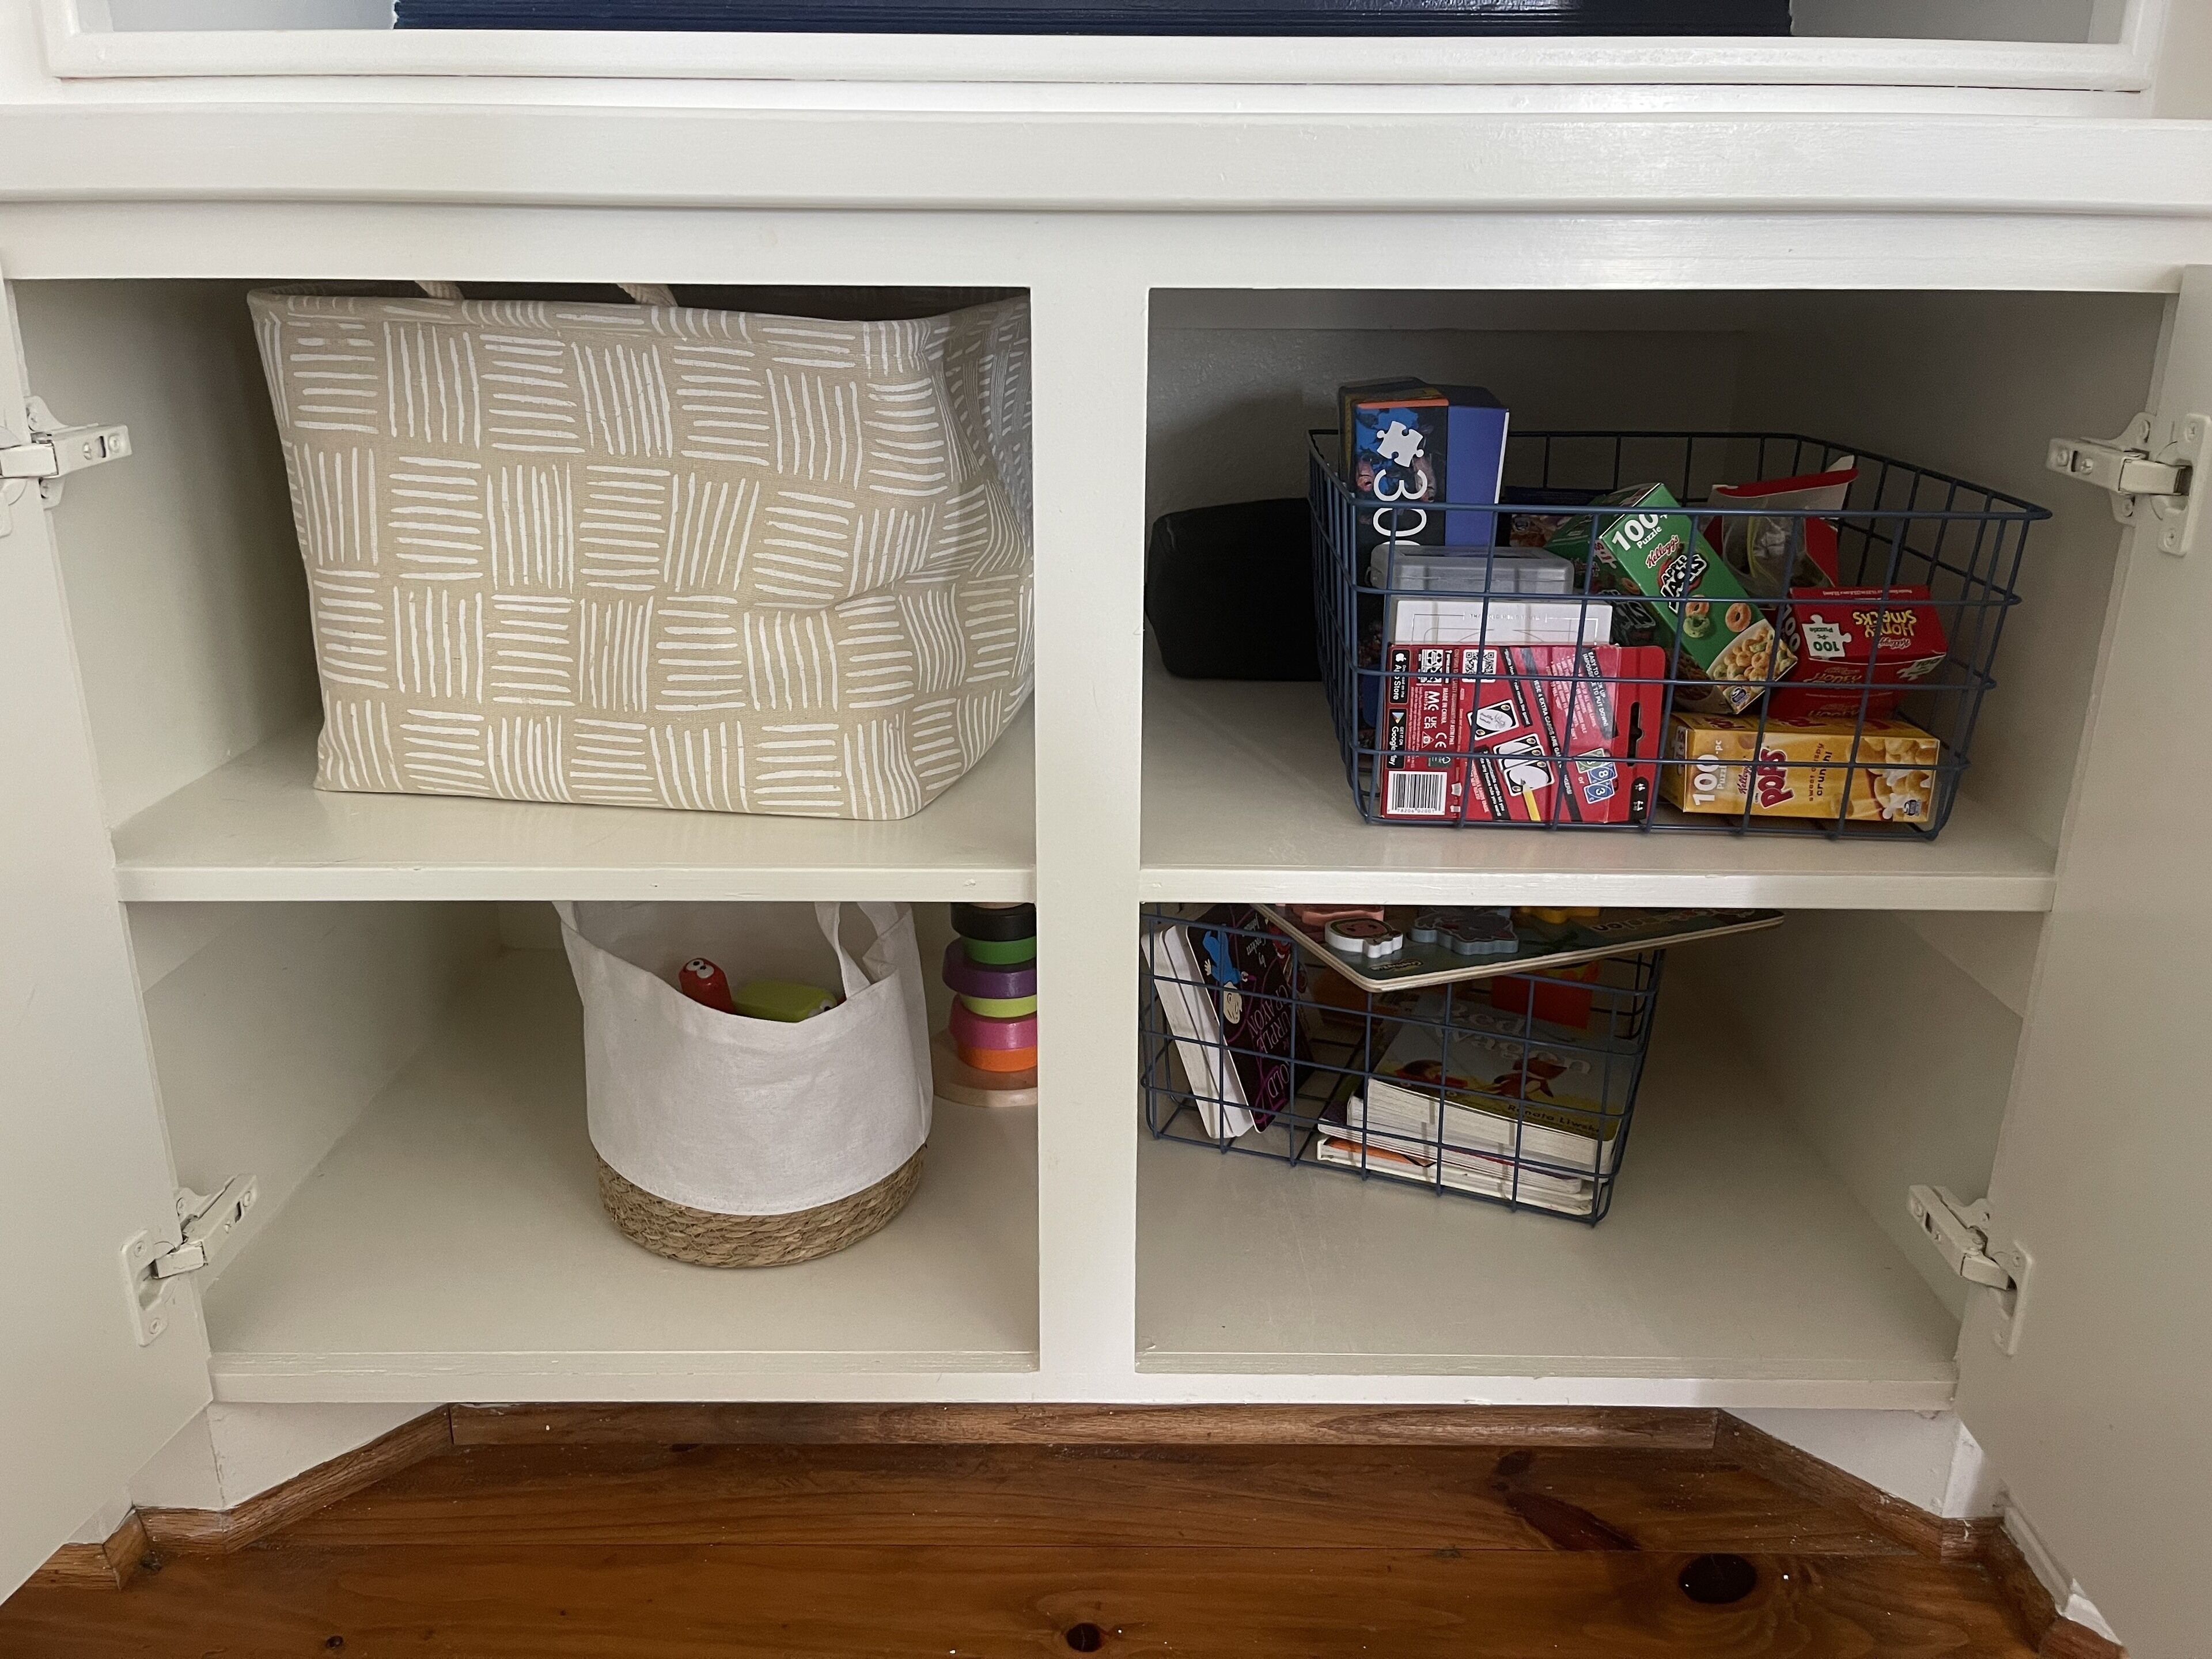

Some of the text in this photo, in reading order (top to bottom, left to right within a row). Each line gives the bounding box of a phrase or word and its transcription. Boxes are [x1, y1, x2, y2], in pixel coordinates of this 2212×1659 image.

[1373, 468, 1427, 547] 30
[1637, 526, 1662, 549] Puzzle
[1646, 535, 1680, 569] Kellogg's
[1813, 641, 1840, 652] 100
[1588, 652, 1597, 666] EASY
[1593, 667, 1599, 675] TO
[1582, 653, 1597, 687] IMPOSSILE
[1598, 707, 1608, 726] DOWN!
[1423, 716, 1430, 729] CA
[1430, 716, 1437, 729] UK
[1539, 698, 1549, 715] EXTRA
[1550, 735, 1558, 747] ARE
[1389, 726, 1399, 751] Google
[1692, 754, 1719, 805] 100
[1715, 740, 1723, 755] -pc
[1811, 743, 1824, 773] cispy
[1599, 770, 1608, 778] 8
[1717, 762, 1728, 790] Puzzl
[1757, 748, 1794, 808] POPS
[1817, 751, 1832, 796] crunh!
[1595, 787, 1605, 796] 3
[1256, 1008, 1294, 1054] URPLE
